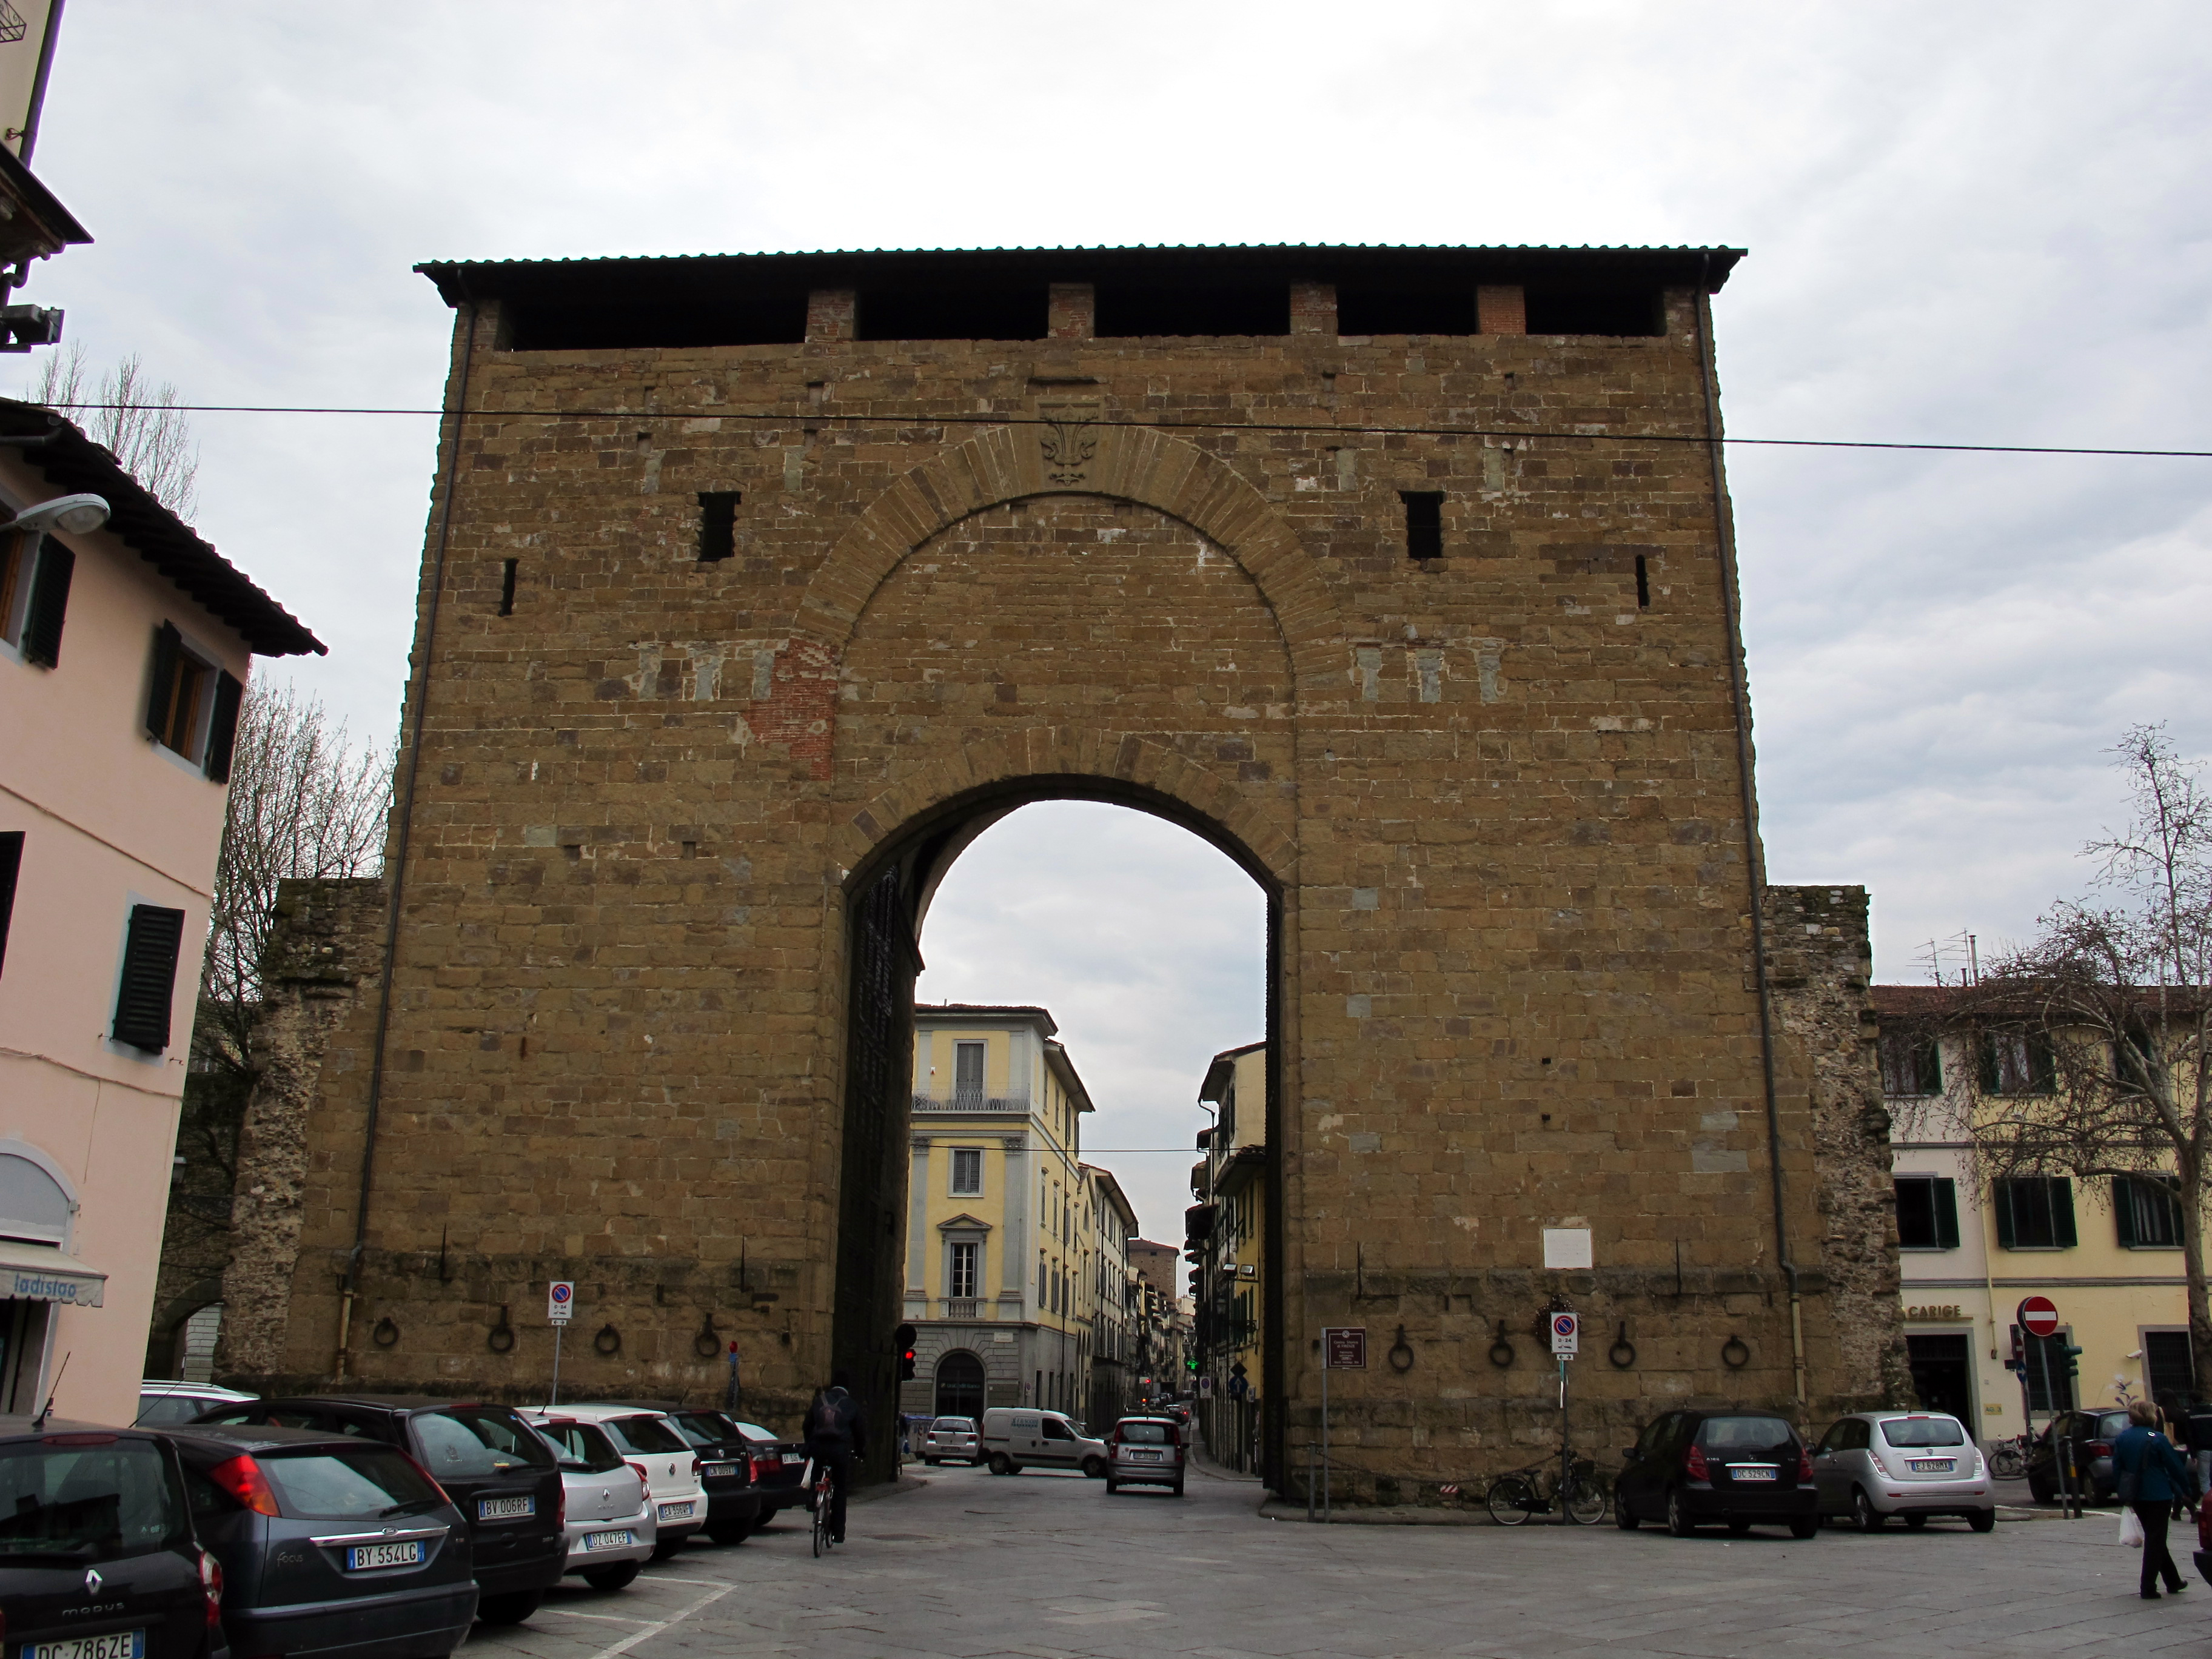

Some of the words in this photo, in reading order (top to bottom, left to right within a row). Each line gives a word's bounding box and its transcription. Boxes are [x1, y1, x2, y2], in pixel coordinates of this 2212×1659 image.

[1908, 1305, 1961, 1317] CARIGE
[486, 1501, 497, 1515] BV
[501, 1498, 528, 1513] 006RF
[592, 1533, 603, 1545] DZ
[605, 1531, 626, 1544] 047EF
[357, 1547, 373, 1566] BY
[378, 1544, 417, 1564] 554LG
[39, 1644, 63, 1659] DC
[72, 1634, 132, 1659] 786ZE
